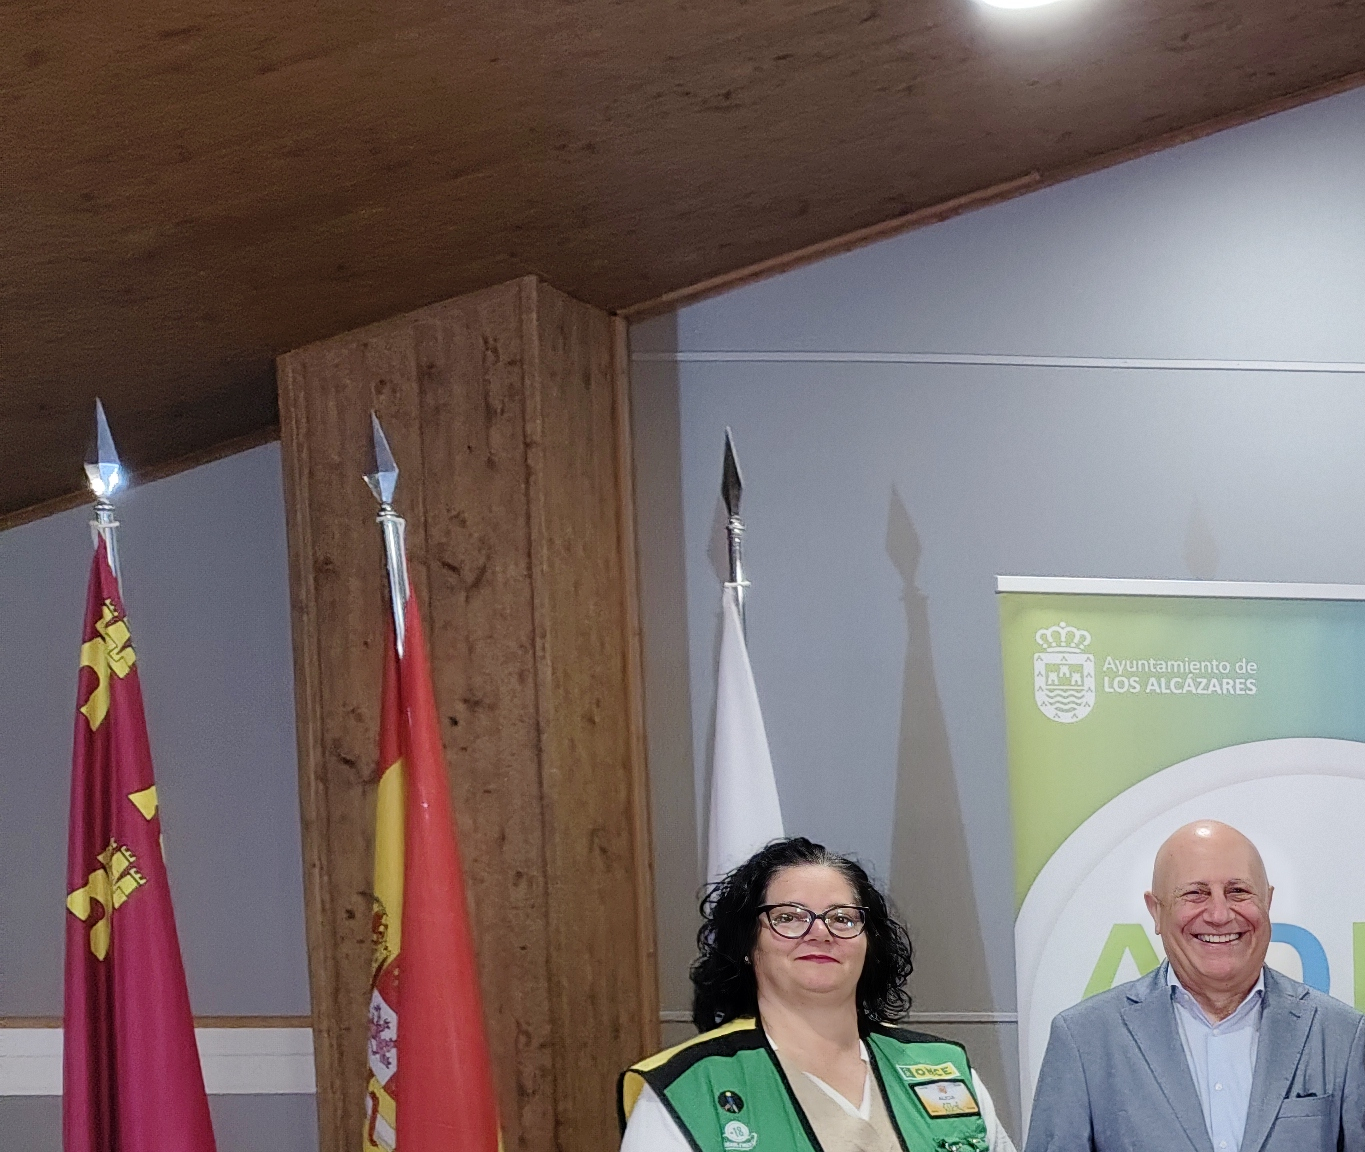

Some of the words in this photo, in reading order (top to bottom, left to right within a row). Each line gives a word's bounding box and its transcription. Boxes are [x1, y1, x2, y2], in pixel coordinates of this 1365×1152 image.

[1102, 656, 1230, 675] Ayuntamiento
[1235, 657, 1258, 674] de
[1103, 676, 1140, 693] LOS
[1146, 673, 1257, 695] ALCÁZARES
